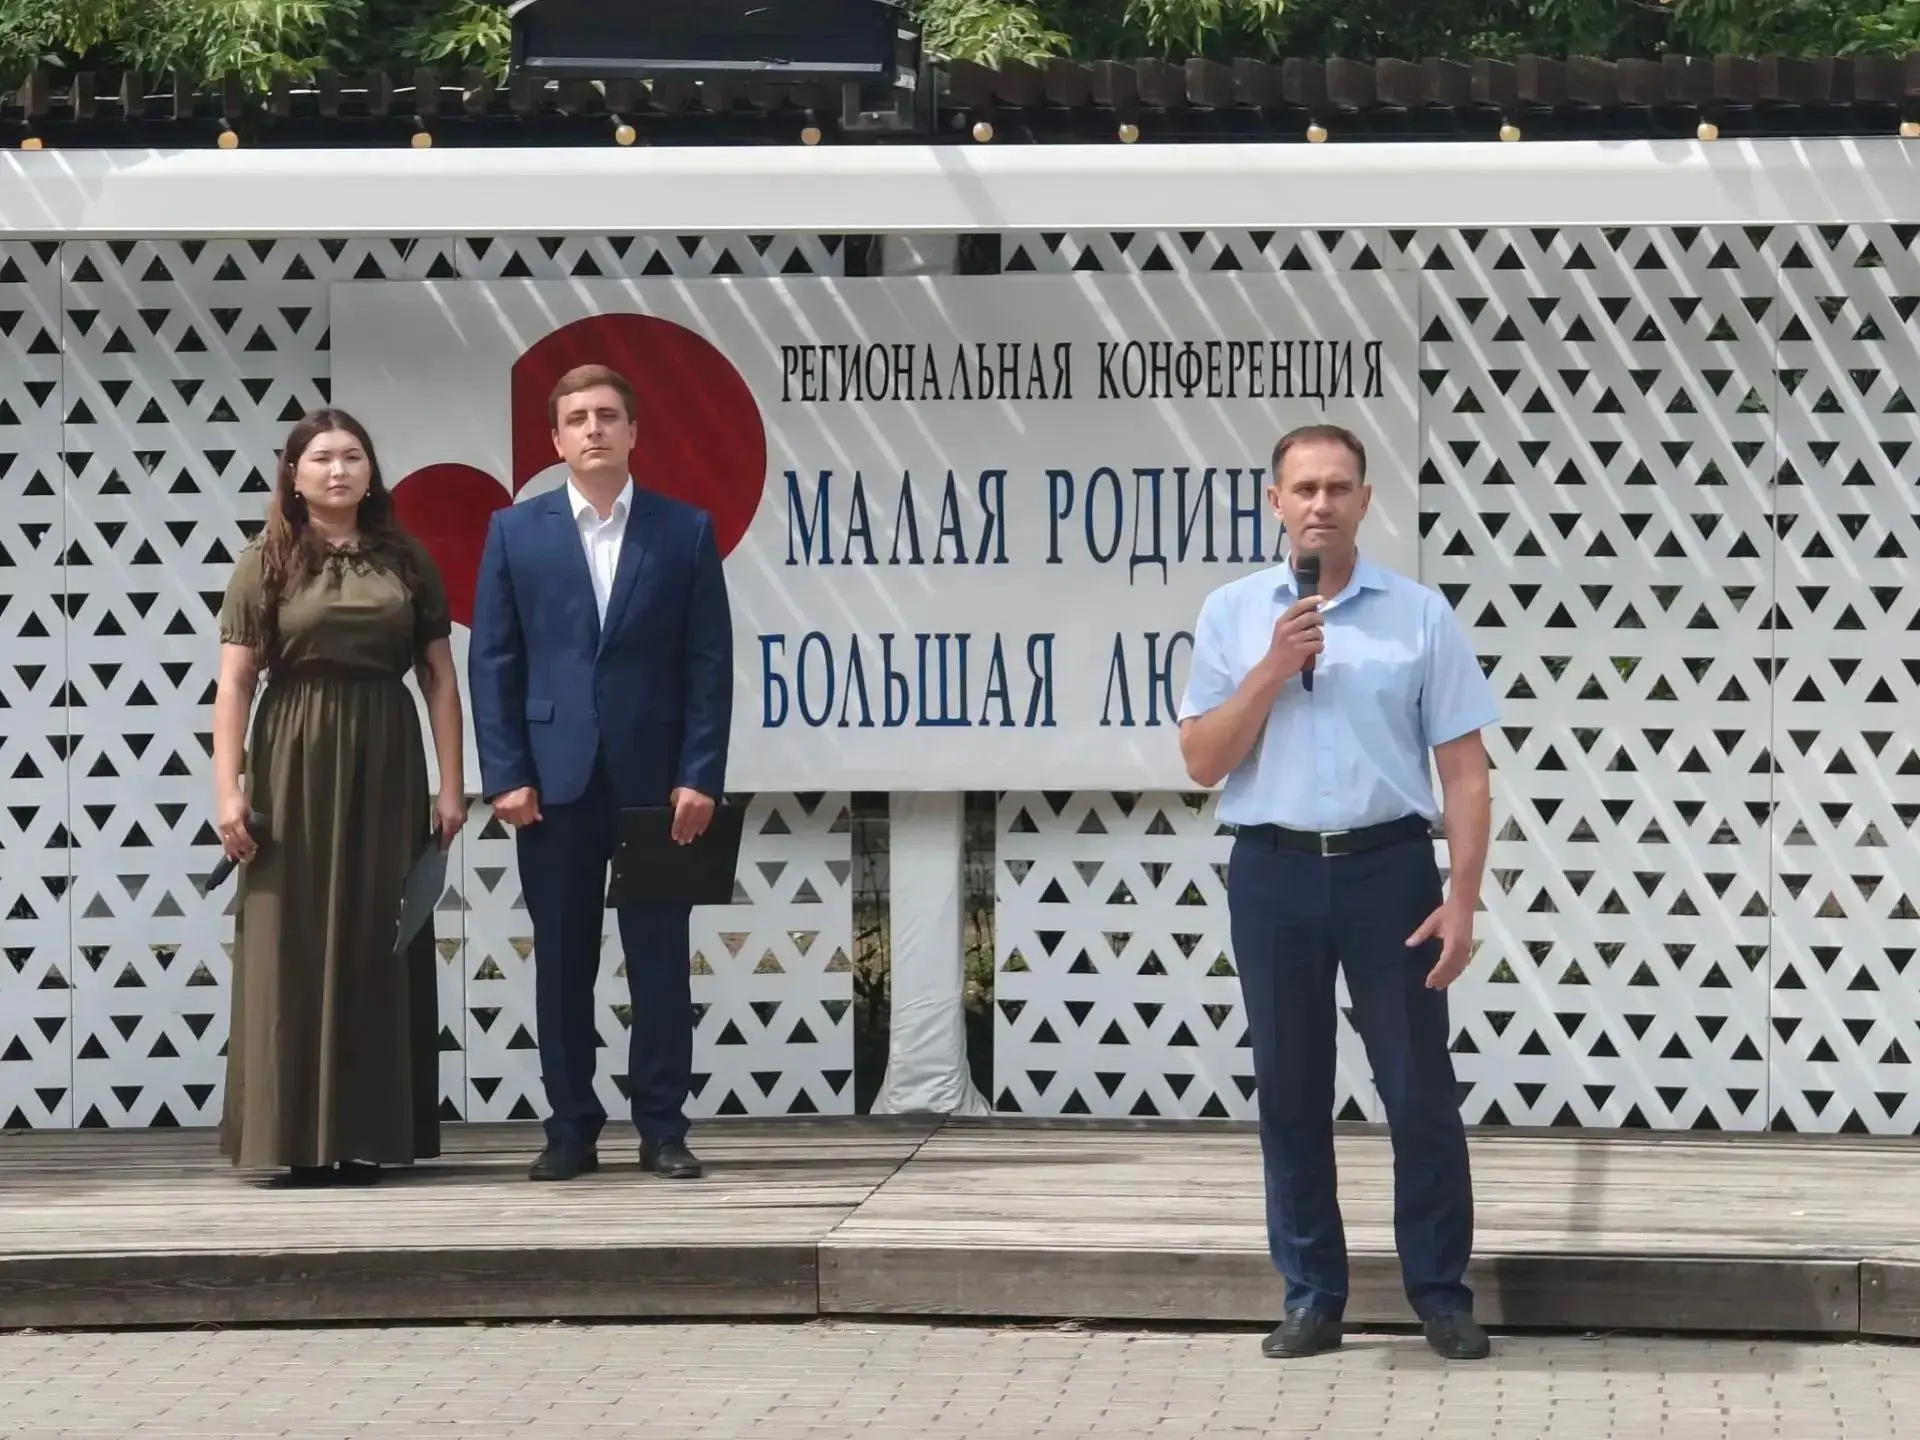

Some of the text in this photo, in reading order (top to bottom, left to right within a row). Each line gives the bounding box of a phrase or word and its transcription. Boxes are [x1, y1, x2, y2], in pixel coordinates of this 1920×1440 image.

[780, 339, 1385, 412] РЕГИОНАЛЬНАЯ КОНФЕРЕНЦИЯ
[783, 468, 1010, 566] МАЛАЯ
[757, 630, 1196, 729] БОЛЬШАЯ ЛЮ
